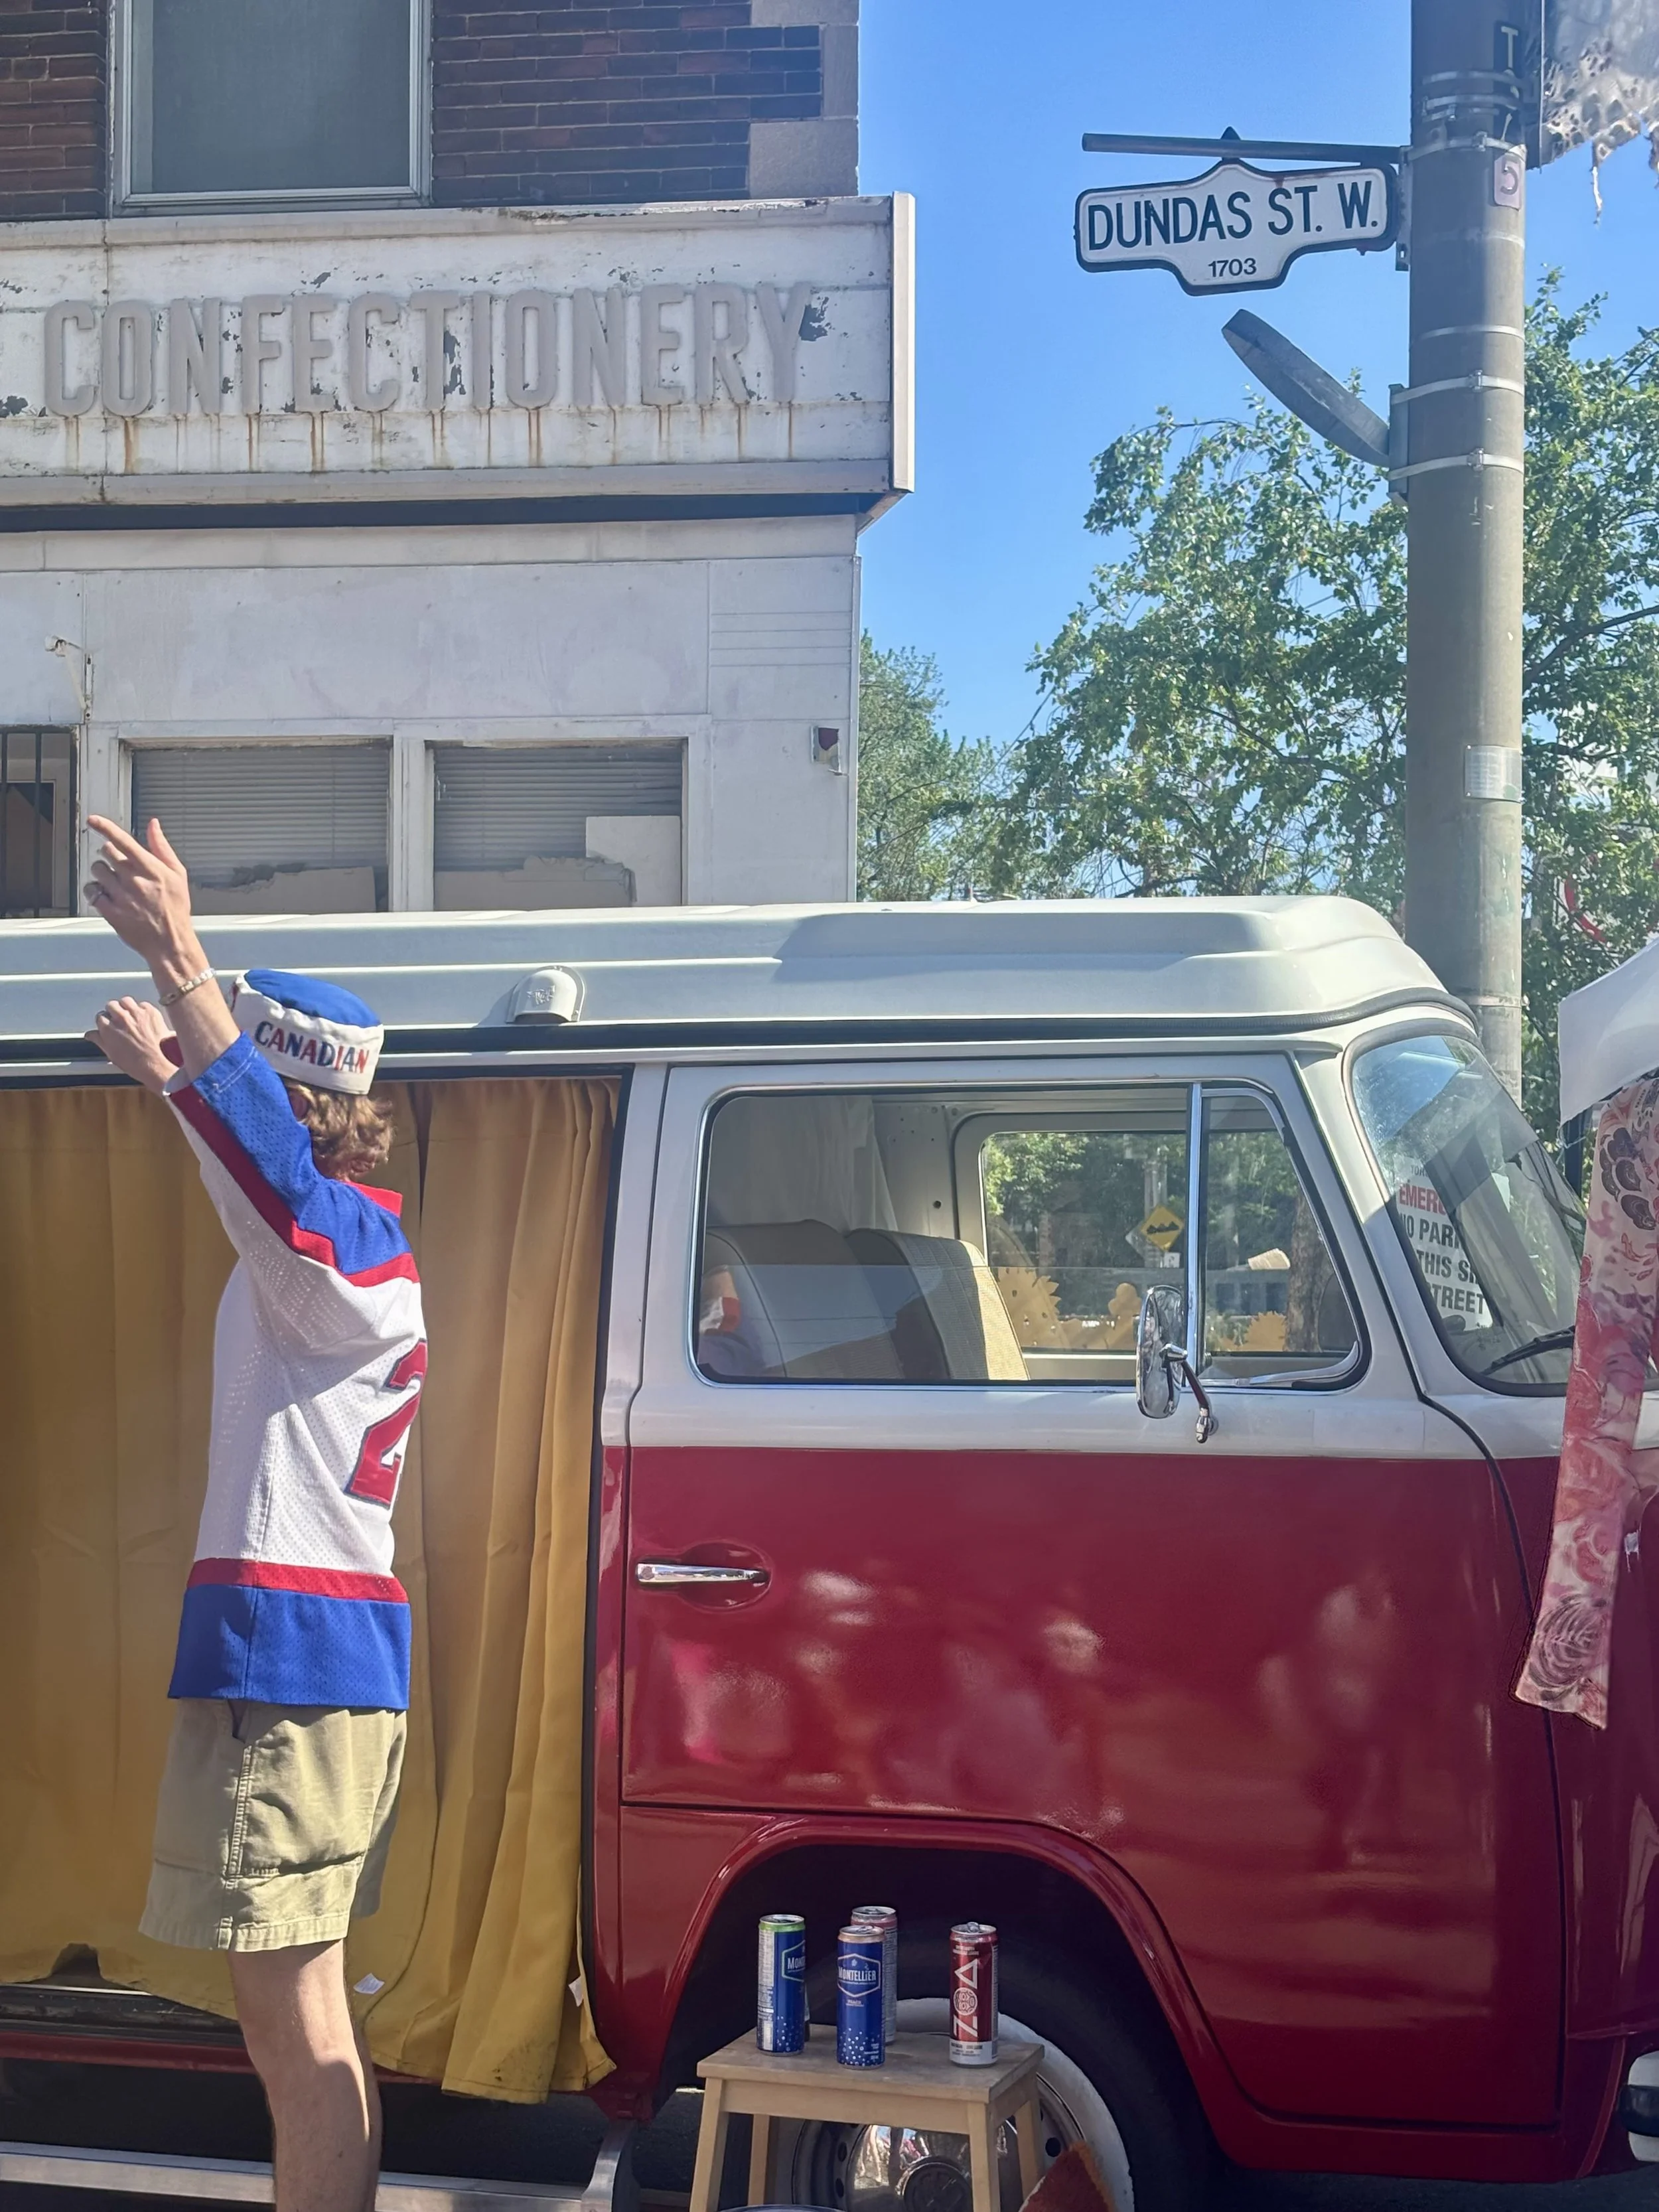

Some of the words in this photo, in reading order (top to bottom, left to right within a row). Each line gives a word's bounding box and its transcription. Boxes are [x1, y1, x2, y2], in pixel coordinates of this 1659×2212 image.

[1499, 159, 1519, 195] 5
[1088, 191, 1252, 250] DUNDAS
[1268, 185, 1323, 236] ST.
[1337, 181, 1378, 230] W.
[1208, 258, 1257, 277] 1703
[43, 281, 811, 416] CONFECTIONERY
[254, 1021, 370, 1073] CANADIAN
[1428, 1283, 1484, 1314] TREET
